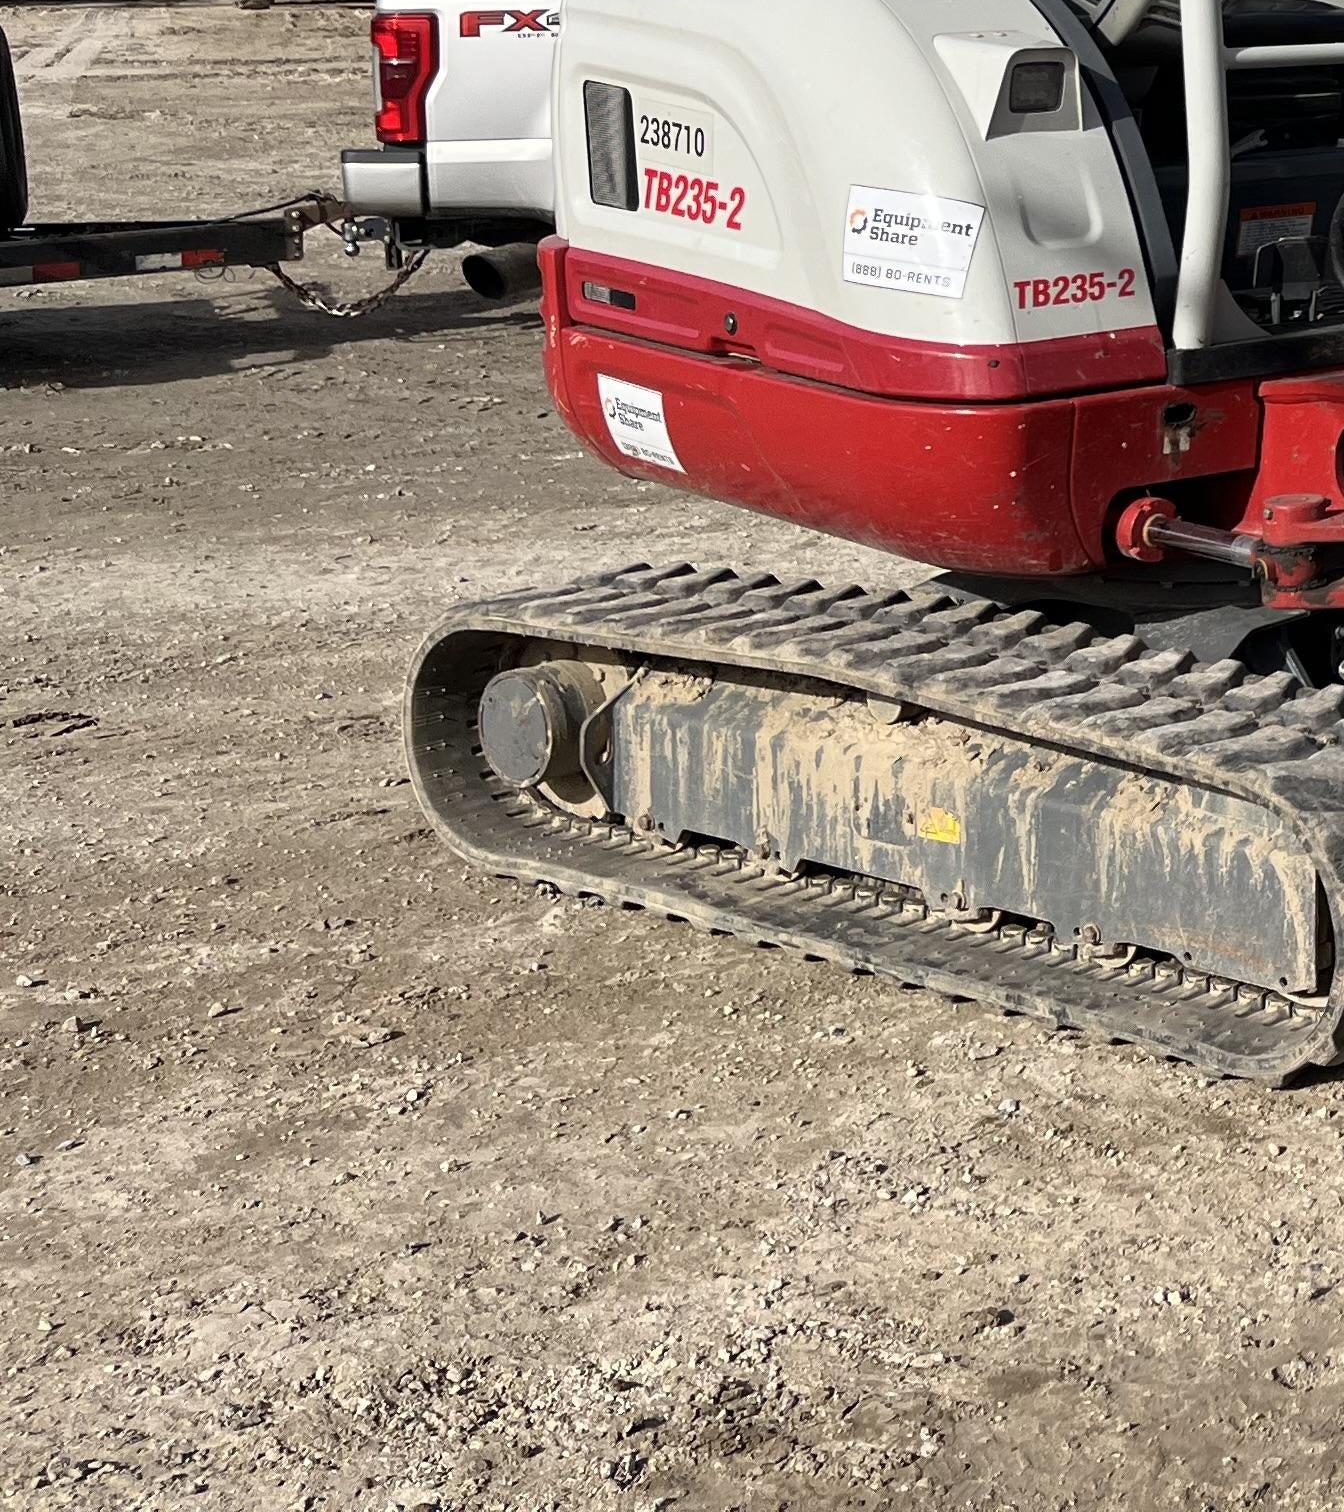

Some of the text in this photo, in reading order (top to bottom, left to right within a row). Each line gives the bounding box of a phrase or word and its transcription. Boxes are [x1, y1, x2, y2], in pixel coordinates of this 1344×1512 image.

[640, 114, 705, 157] 238710
[644, 167, 745, 231] TB235-2
[869, 226, 918, 245] Share
[872, 208, 973, 236] Equipent
[851, 262, 951, 287] (888) 80-RENTS
[1013, 268, 1135, 309] TB235-2
